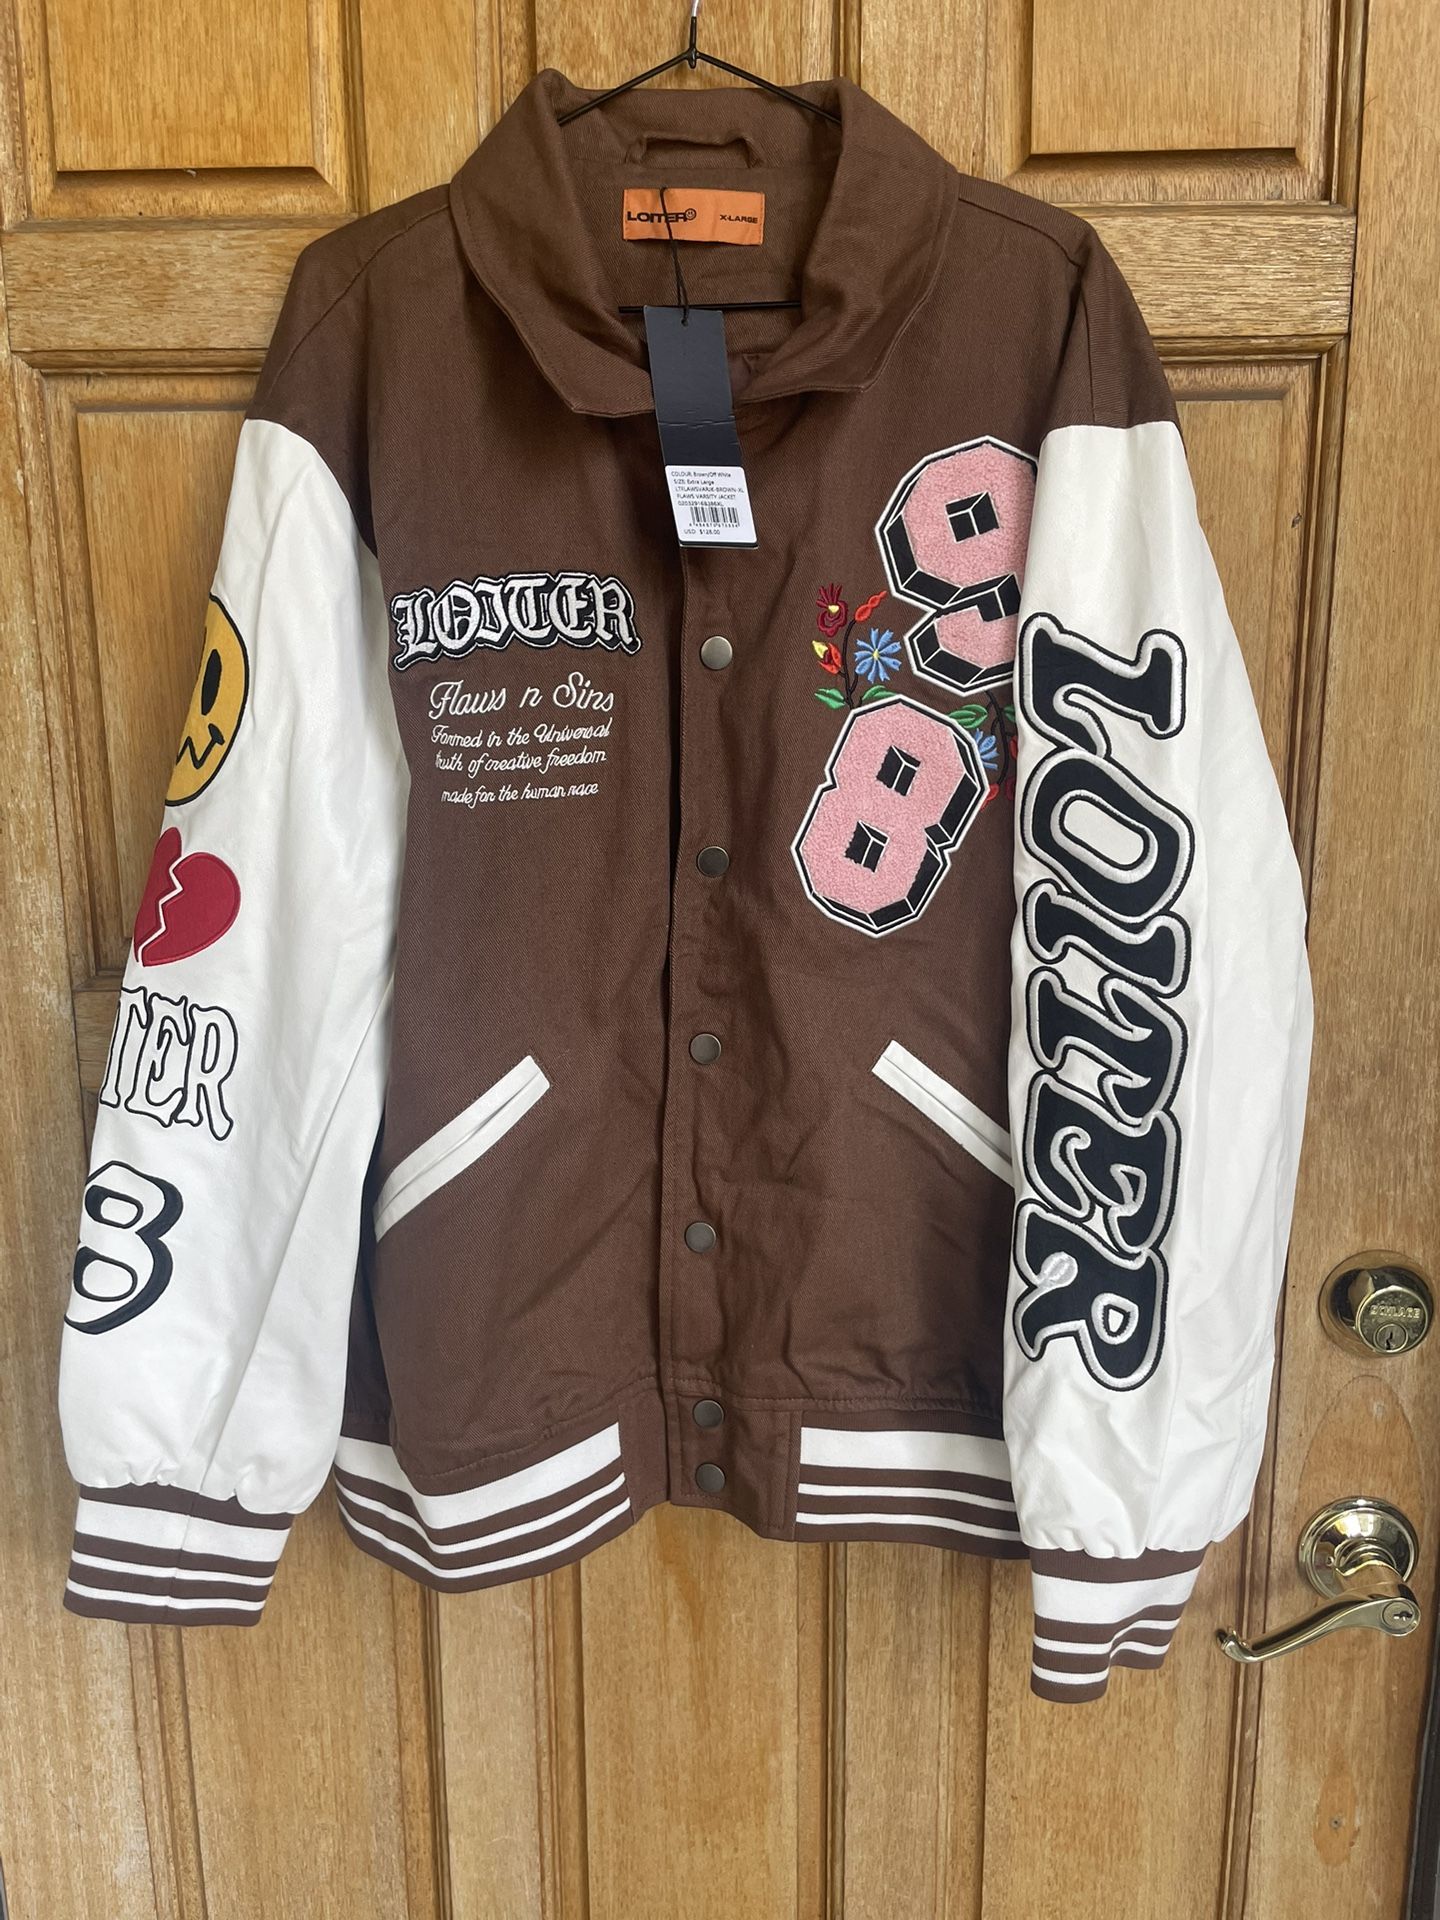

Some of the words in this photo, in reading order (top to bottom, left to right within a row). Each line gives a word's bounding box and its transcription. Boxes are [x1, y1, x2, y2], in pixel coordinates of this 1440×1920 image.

[627, 211, 688, 224] LOITER
[719, 214, 758, 224] X-LARGE
[390, 569, 642, 671] LOITER
[428, 680, 507, 720] Flaws
[519, 687, 542, 709] n
[552, 671, 614, 713] Sins
[431, 724, 483, 748] Formed
[487, 730, 502, 748] in
[506, 727, 530, 746] the
[534, 717, 613, 744] Universal
[435, 749, 463, 772] truth
[467, 752, 489, 779] of
[484, 751, 542, 772] creative
[539, 745, 607, 775] freedom
[440, 787, 474, 804] made
[467, 785, 496, 809] for
[497, 784, 519, 802] the
[520, 782, 566, 800] human
[567, 783, 599, 797] race
[790, 694, 990, 938] 8
[1012, 611, 1195, 1391] LOITER
